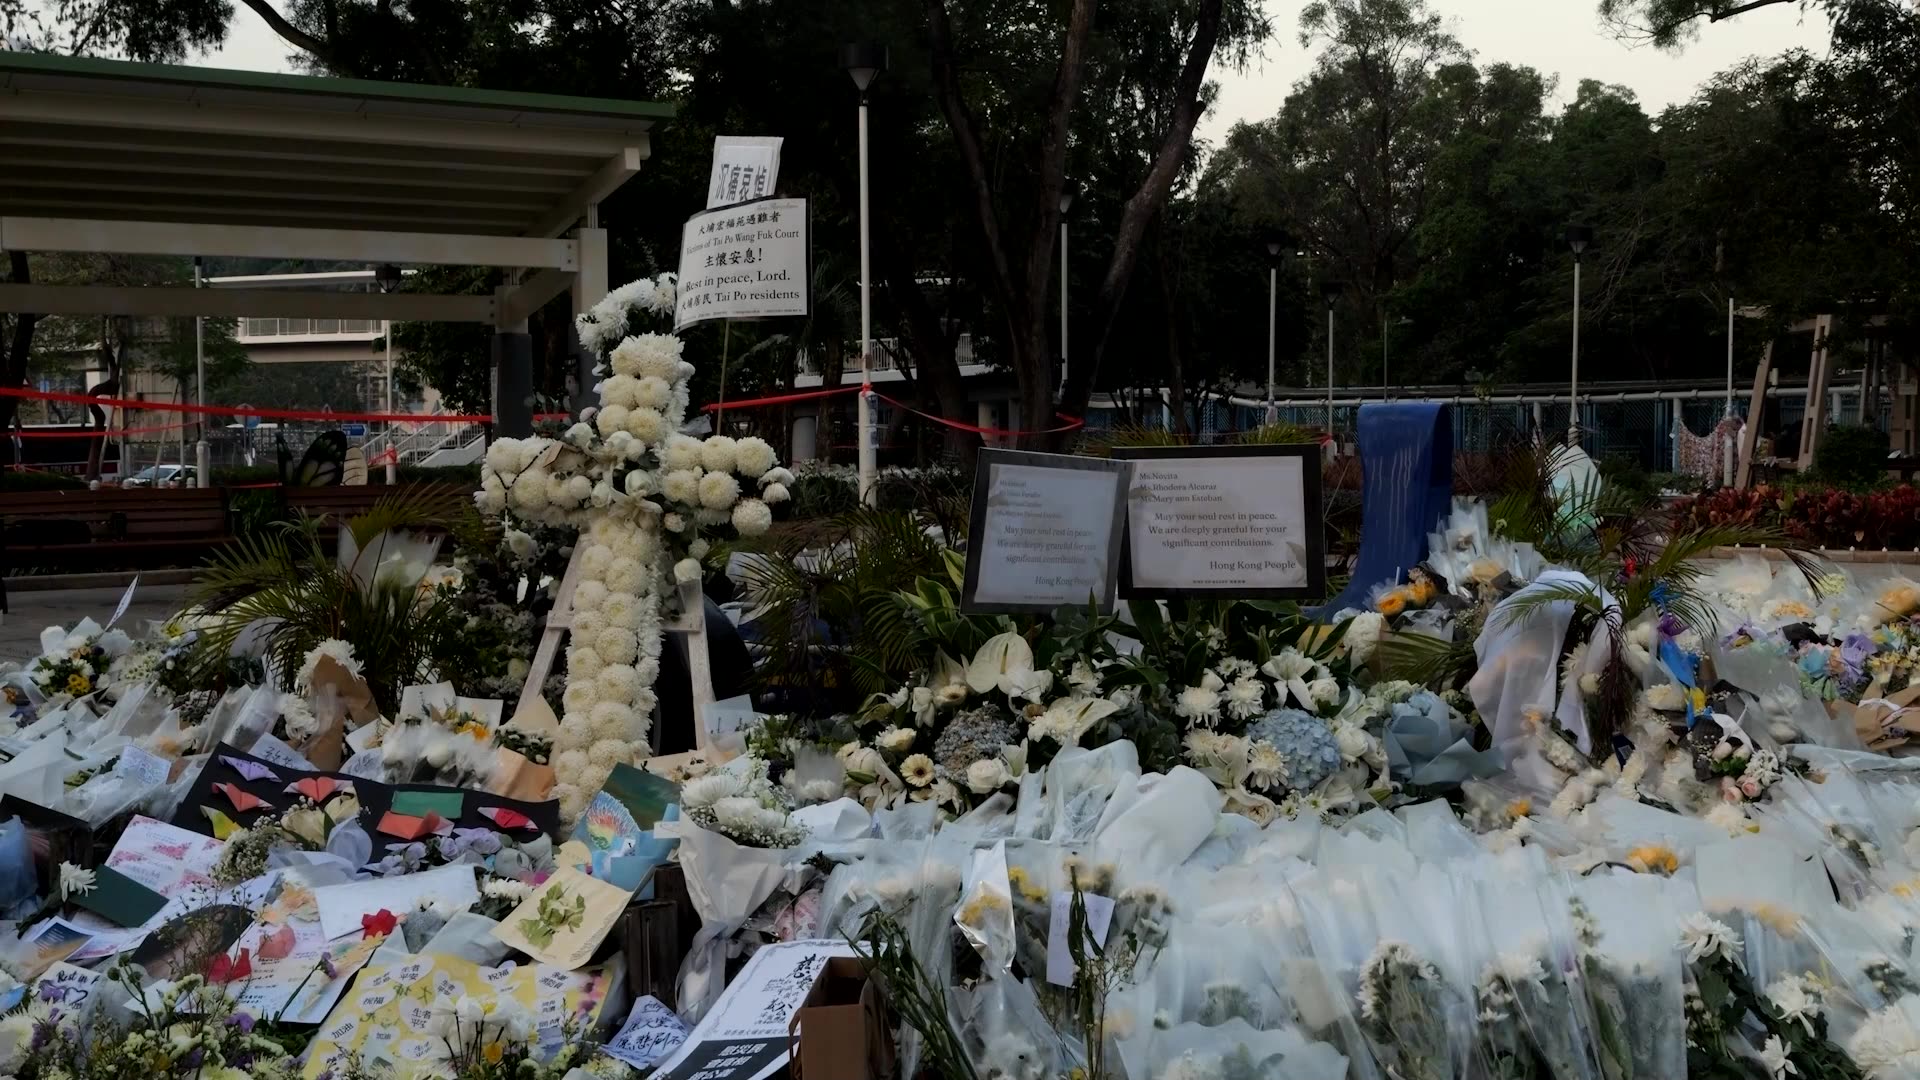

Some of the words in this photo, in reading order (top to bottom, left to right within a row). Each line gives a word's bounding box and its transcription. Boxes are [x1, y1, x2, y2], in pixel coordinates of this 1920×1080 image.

[716, 163, 767, 201] 沉痛哀悼
[698, 210, 781, 236] 大埔宏福苑遇難者
[713, 237, 723, 246] Tai
[724, 235, 733, 244] Po
[735, 233, 755, 243] Wang
[757, 230, 773, 240] Fuk
[775, 229, 799, 239] Court
[686, 278, 702, 292] Rest
[704, 276, 714, 287] in
[716, 274, 753, 289] peace,
[757, 269, 791, 282] Lord.
[681, 293, 711, 312] 大埔居民
[715, 292, 730, 302] Tai
[734, 291, 747, 301] Po
[750, 289, 800, 300] residents
[1139, 472, 1178, 481] Ms.Novita
[1188, 483, 1217, 491] Alcaraz
[1154, 513, 1173, 522] May
[1174, 514, 1197, 522] your
[1198, 512, 1216, 521] soul
[1219, 513, 1235, 521] rest
[1238, 513, 1247, 521] in
[1249, 513, 1277, 522] peace.
[1148, 525, 1163, 534] We
[1181, 525, 1210, 535] deeply
[1212, 525, 1248, 535] grateful
[1250, 525, 1263, 534] for
[1265, 527, 1287, 536] your
[1161, 538, 1208, 549] significant
[1210, 538, 1274, 547] contributions.
[1210, 560, 1235, 571] Hong
[1237, 560, 1262, 571] Kong
[1264, 560, 1296, 571] People
[1035, 575, 1055, 587] Hong
[1055, 575, 1073, 587] Kong
[56, 970, 77, 983] Rest
[77, 974, 88, 983] in
